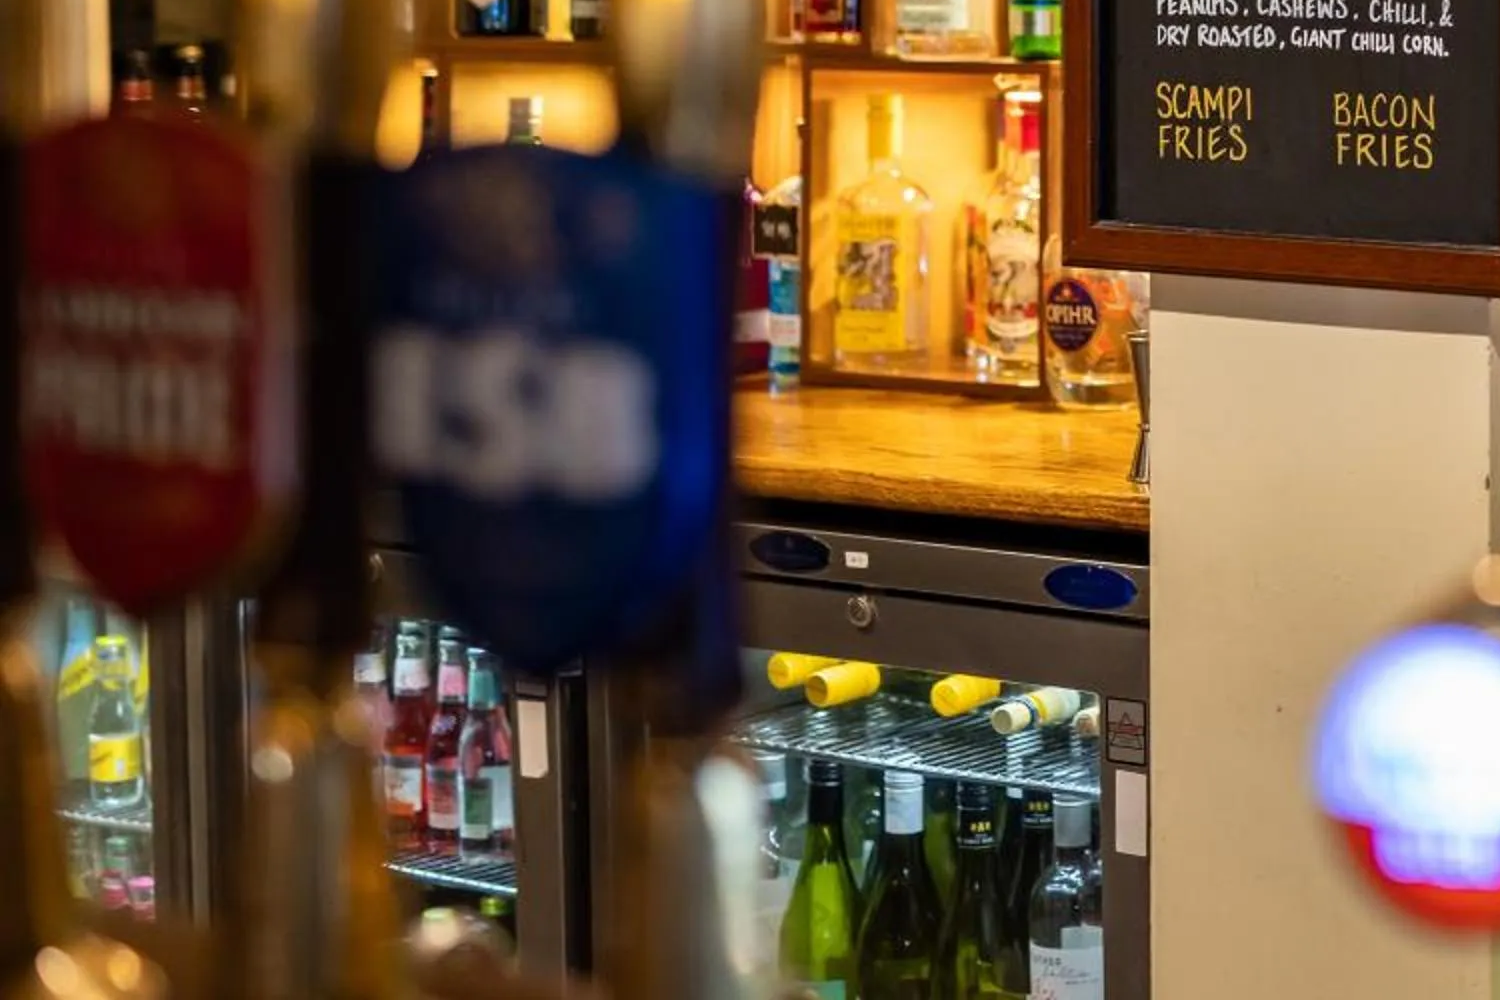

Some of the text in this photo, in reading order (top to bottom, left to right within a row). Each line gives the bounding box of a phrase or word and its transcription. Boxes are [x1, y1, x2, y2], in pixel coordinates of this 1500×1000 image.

[1157, 24, 1189, 47] DRY
[1291, 27, 1346, 49] GIANT
[1351, 33, 1395, 54] CHILLI
[1156, 81, 1436, 130] SCAMPI BACON
[1159, 125, 1433, 169] FRIES FRIES
[1046, 304, 1097, 327] OPIHR
